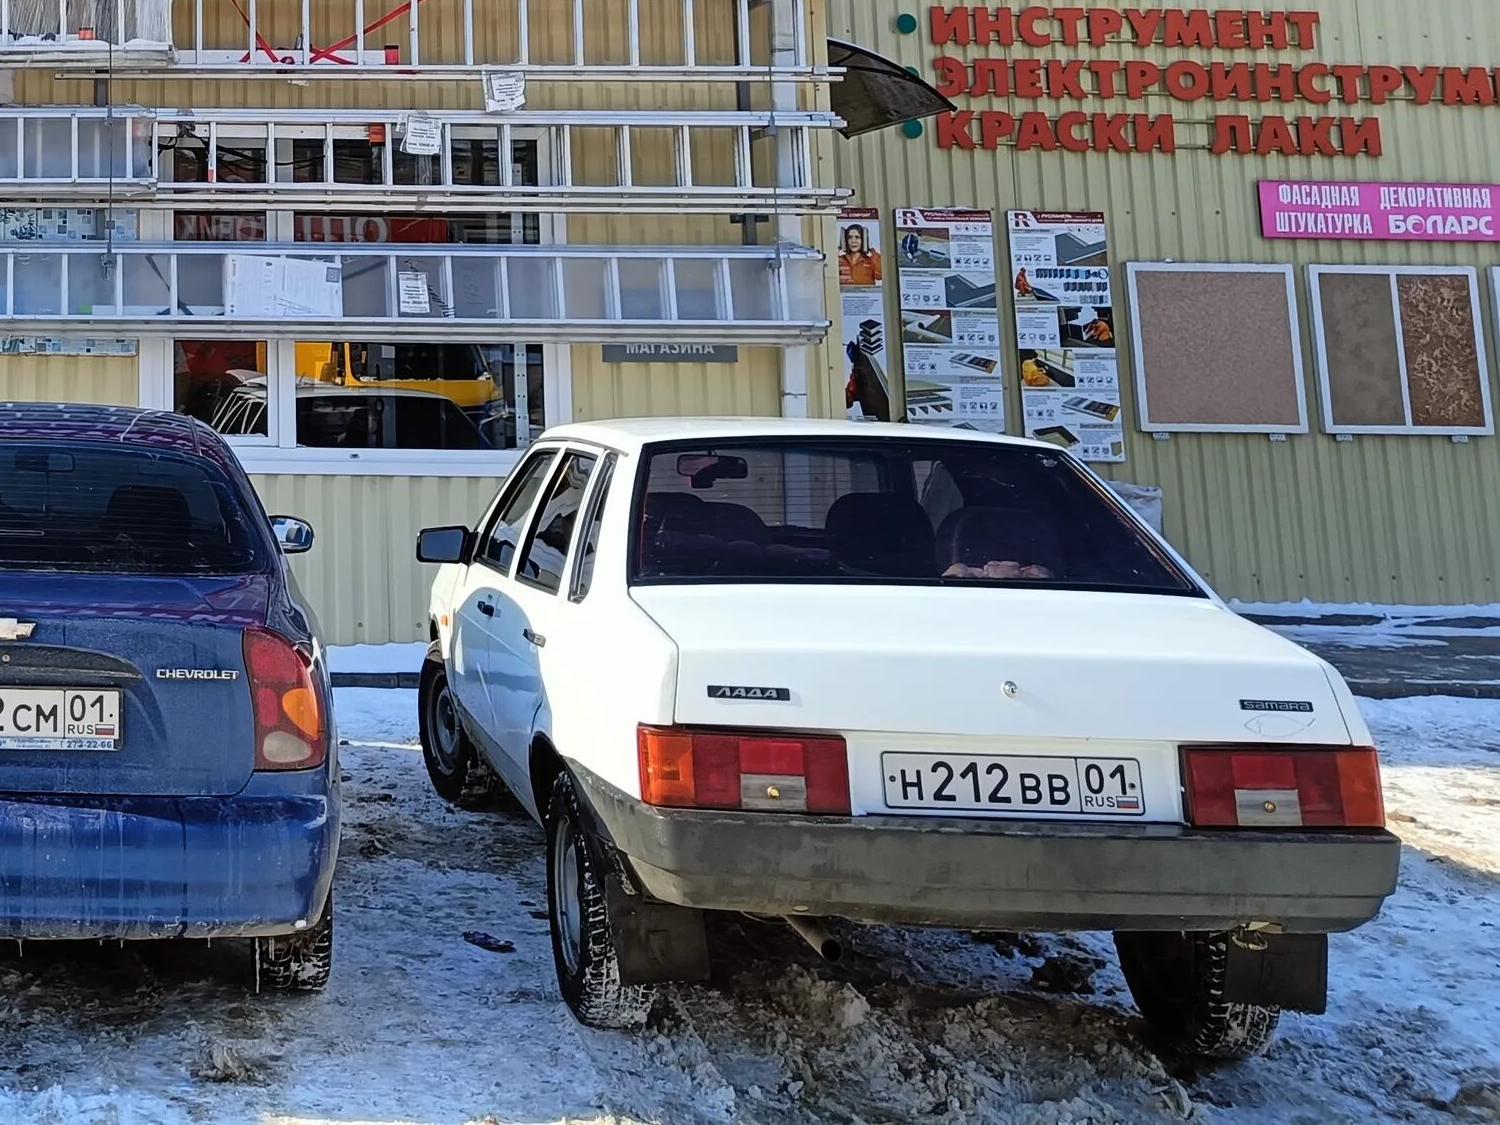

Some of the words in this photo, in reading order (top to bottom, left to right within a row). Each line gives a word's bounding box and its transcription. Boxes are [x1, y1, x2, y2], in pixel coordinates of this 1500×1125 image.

[929, 6, 1320, 51] ИНСТРУМЕНТ
[934, 56, 1500, 106] ЭЛЕКТРОИНСТРУМ
[935, 109, 1176, 153] КРАСКИ
[1211, 114, 1383, 158] ЛАКИ
[1278, 184, 1359, 208] ФАСАДНАЯ
[1380, 186, 1491, 209] ДЕКОРАТИВНАЯ
[1276, 212, 1372, 234] ШТУКАТУРКА
[1389, 215, 1494, 235] БОЛАРС
[156, 668, 239, 680] CHEVROLET
[715, 687, 778, 698] ЛАДА
[70, 694, 105, 722] 01
[68, 724, 94, 735] RUS
[900, 761, 1071, 806] Н212ВВ
[1084, 763, 1128, 796] 01
[1085, 796, 1116, 808] RUS
